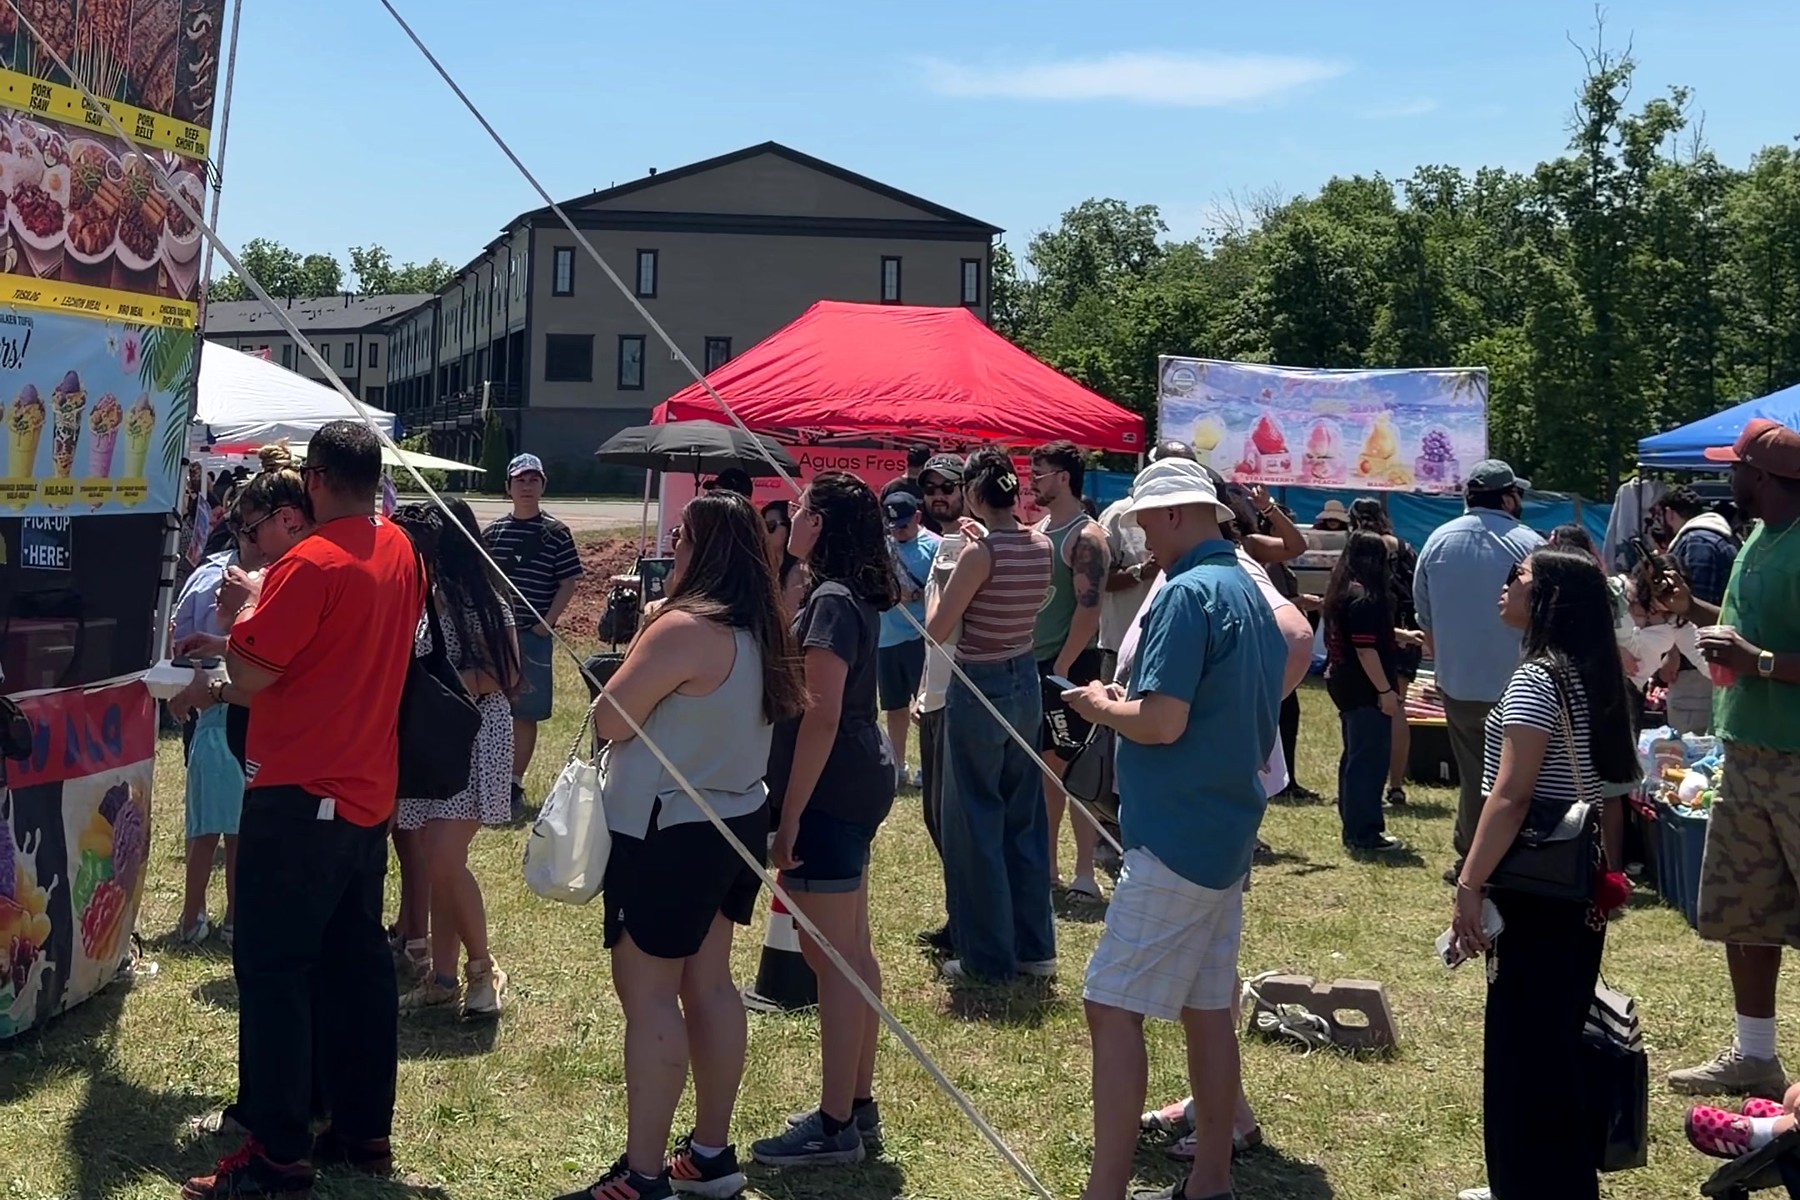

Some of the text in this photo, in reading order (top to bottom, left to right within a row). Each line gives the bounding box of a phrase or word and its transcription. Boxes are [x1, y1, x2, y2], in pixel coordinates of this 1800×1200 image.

[31, 83, 52, 99] PORK
[29, 96, 50, 112] ISAW
[81, 97, 111, 113] CHIEN
[84, 111, 103, 127] ISAW
[137, 113, 155, 128] PORK
[135, 125, 154, 140] BELLY
[185, 127, 199, 141] BEEF
[175, 137, 194, 151] SHORT
[85, 300, 101, 311] MEAL
[118, 304, 130, 316] BBQ
[129, 306, 144, 317] MEAL
[800, 452, 907, 471] Aguas Fres
[1245, 475, 1295, 483] STRAWBERRY
[24, 516, 71, 532] PICK-UP
[30, 544, 65, 567] HERE
